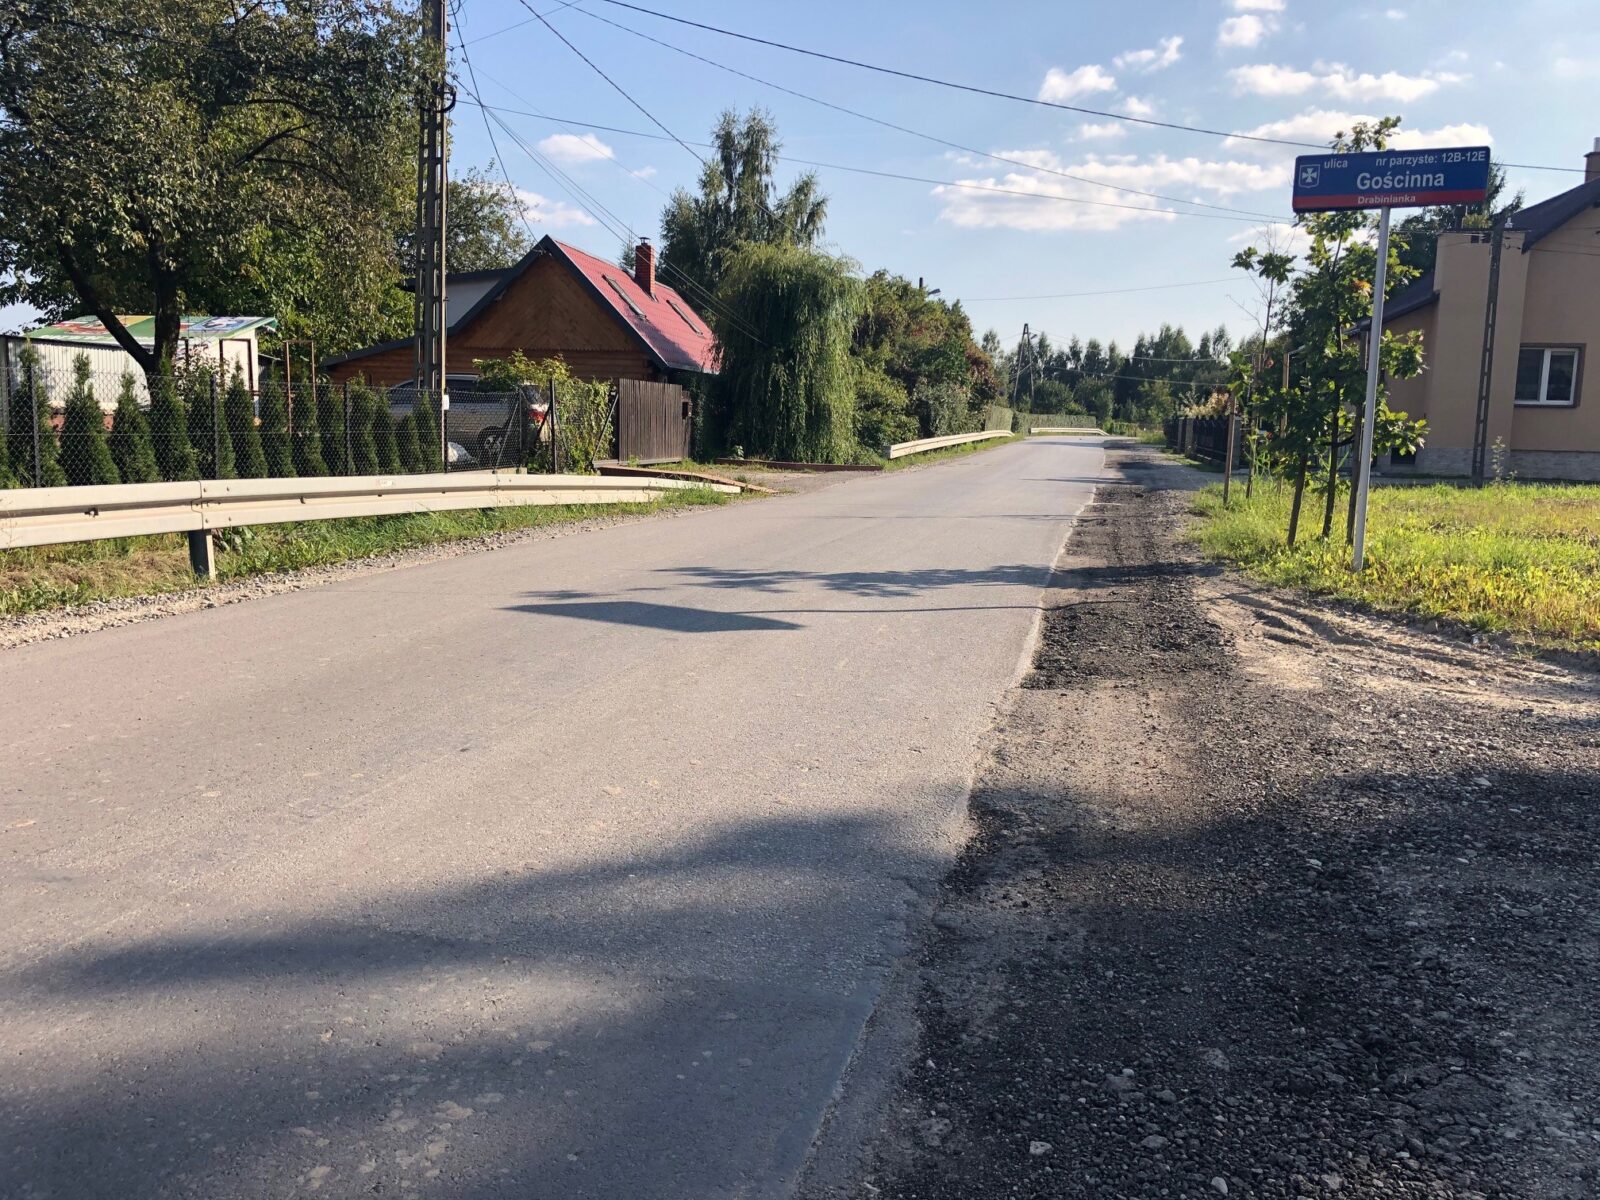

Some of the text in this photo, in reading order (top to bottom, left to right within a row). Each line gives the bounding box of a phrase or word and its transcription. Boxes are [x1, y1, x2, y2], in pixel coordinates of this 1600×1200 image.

[1324, 158, 1348, 169] ulica
[1375, 151, 1486, 168] nr parzyste: 12B-12E
[1356, 170, 1445, 190] Gościnna
[1357, 194, 1416, 204] Drabinianka
